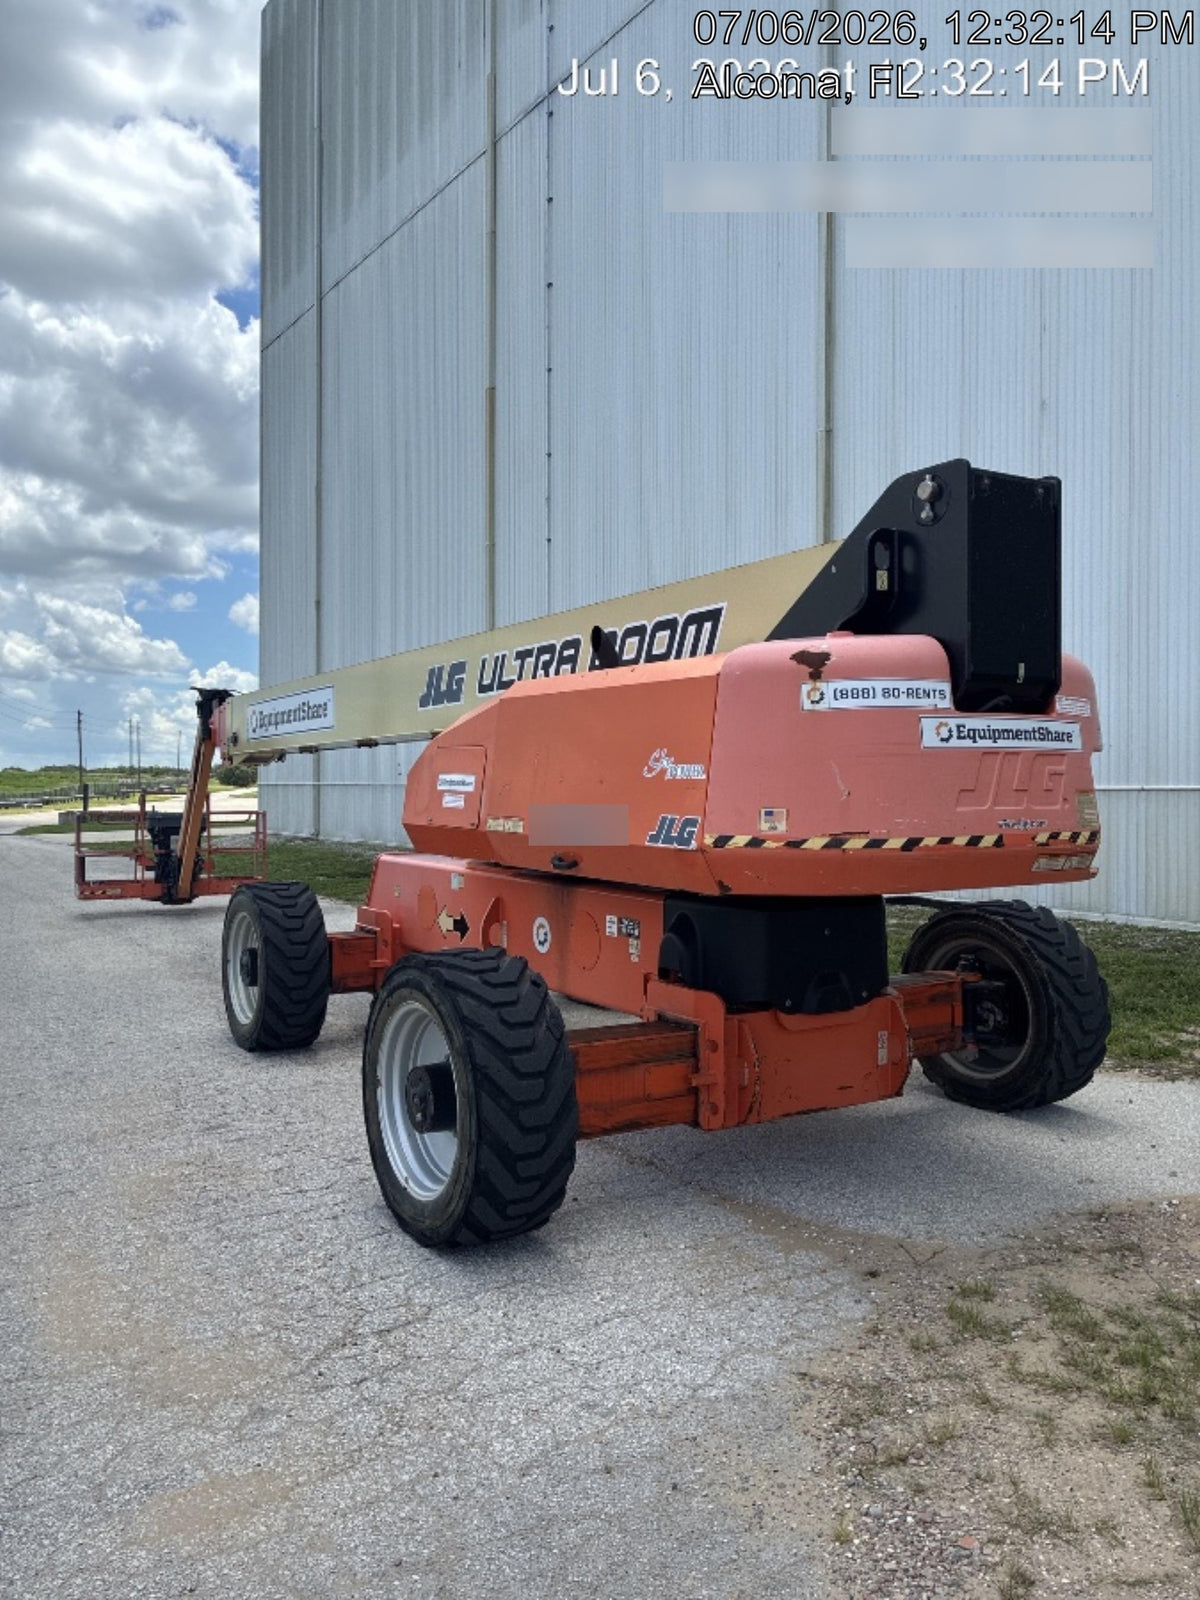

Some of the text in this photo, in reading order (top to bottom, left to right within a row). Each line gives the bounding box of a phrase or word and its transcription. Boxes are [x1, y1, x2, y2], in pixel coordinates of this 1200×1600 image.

[476, 635, 583, 696] ULTRA
[417, 660, 467, 711] JLG
[833, 686, 947, 702] (888) 80-RENTS
[955, 723, 1073, 743] EquipmentShare
[645, 813, 701, 850] JLG
